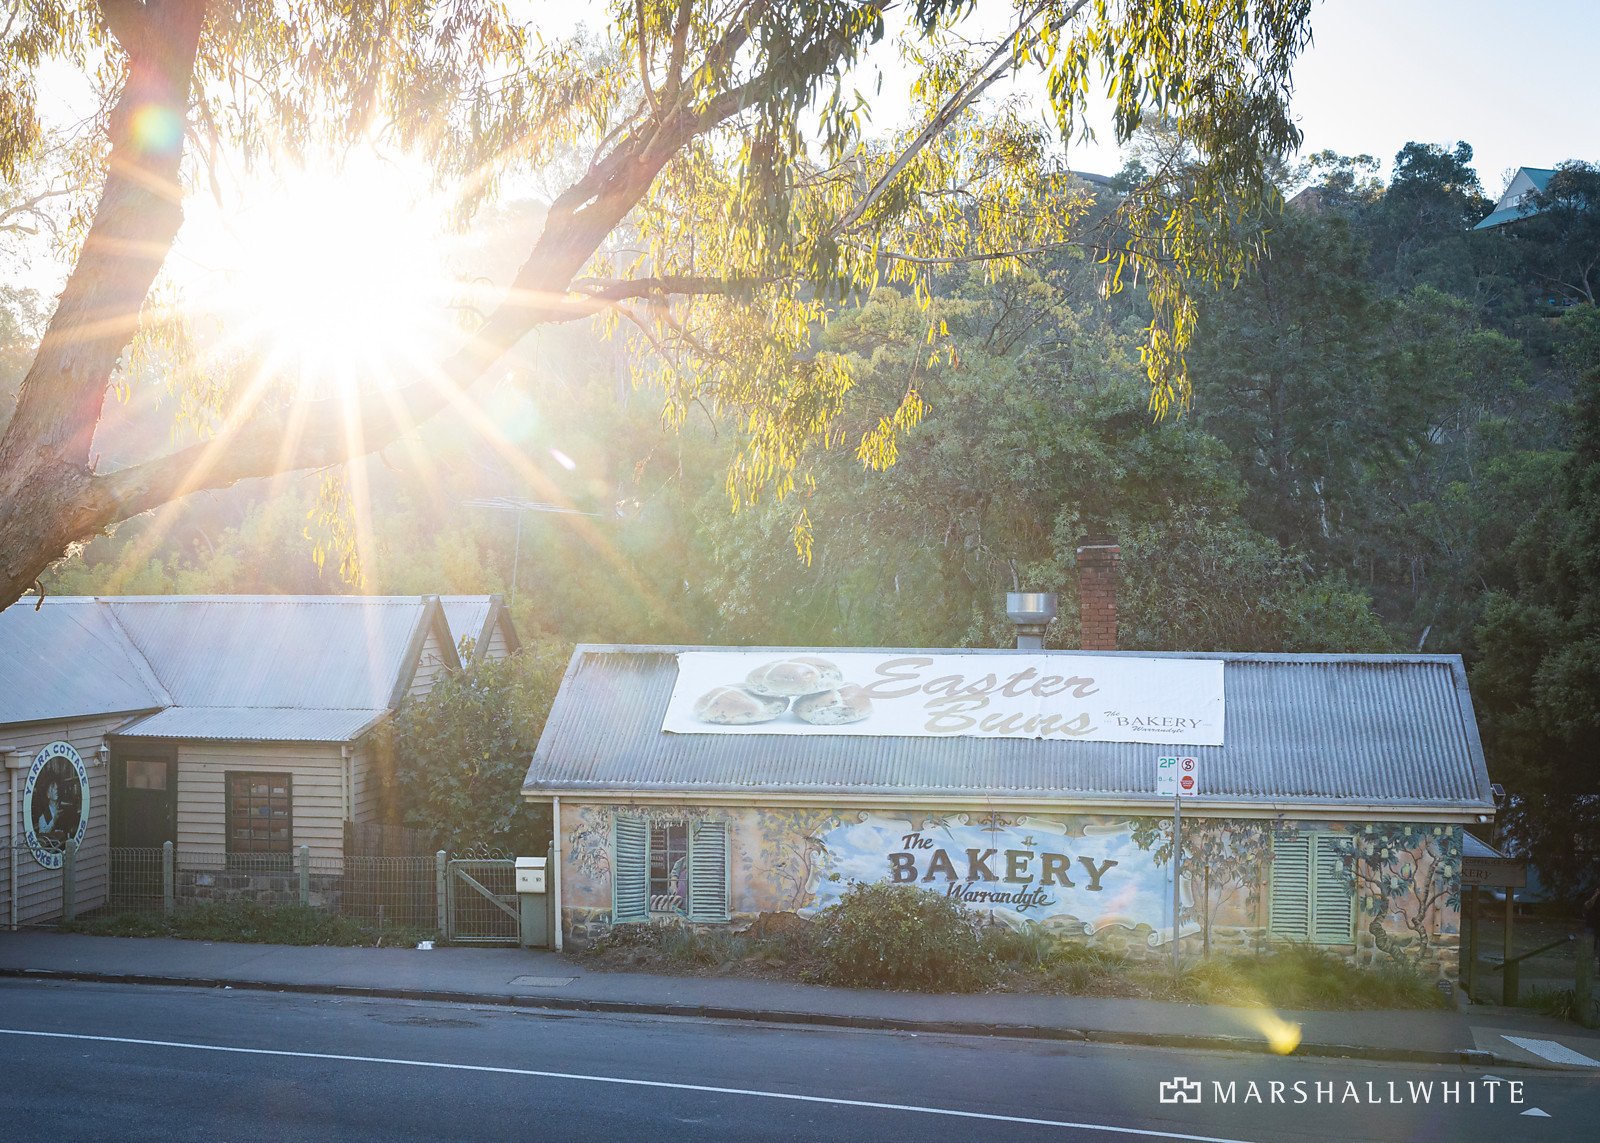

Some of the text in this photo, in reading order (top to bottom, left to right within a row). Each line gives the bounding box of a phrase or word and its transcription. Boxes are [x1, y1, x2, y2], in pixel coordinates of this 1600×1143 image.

[864, 657, 1100, 700] Easter
[923, 691, 1098, 736] Buns
[1117, 716, 1202, 729] BAKERY
[26, 744, 88, 795] YARRA COTTAGE
[1159, 758, 1176, 768] 2P
[27, 831, 52, 866] BOOKS
[74, 820, 86, 845] IOS
[902, 832, 934, 850] The
[887, 848, 1119, 892] BAKERY
[1461, 868, 1492, 879] KERY
[946, 882, 1056, 912] Warrandyte
